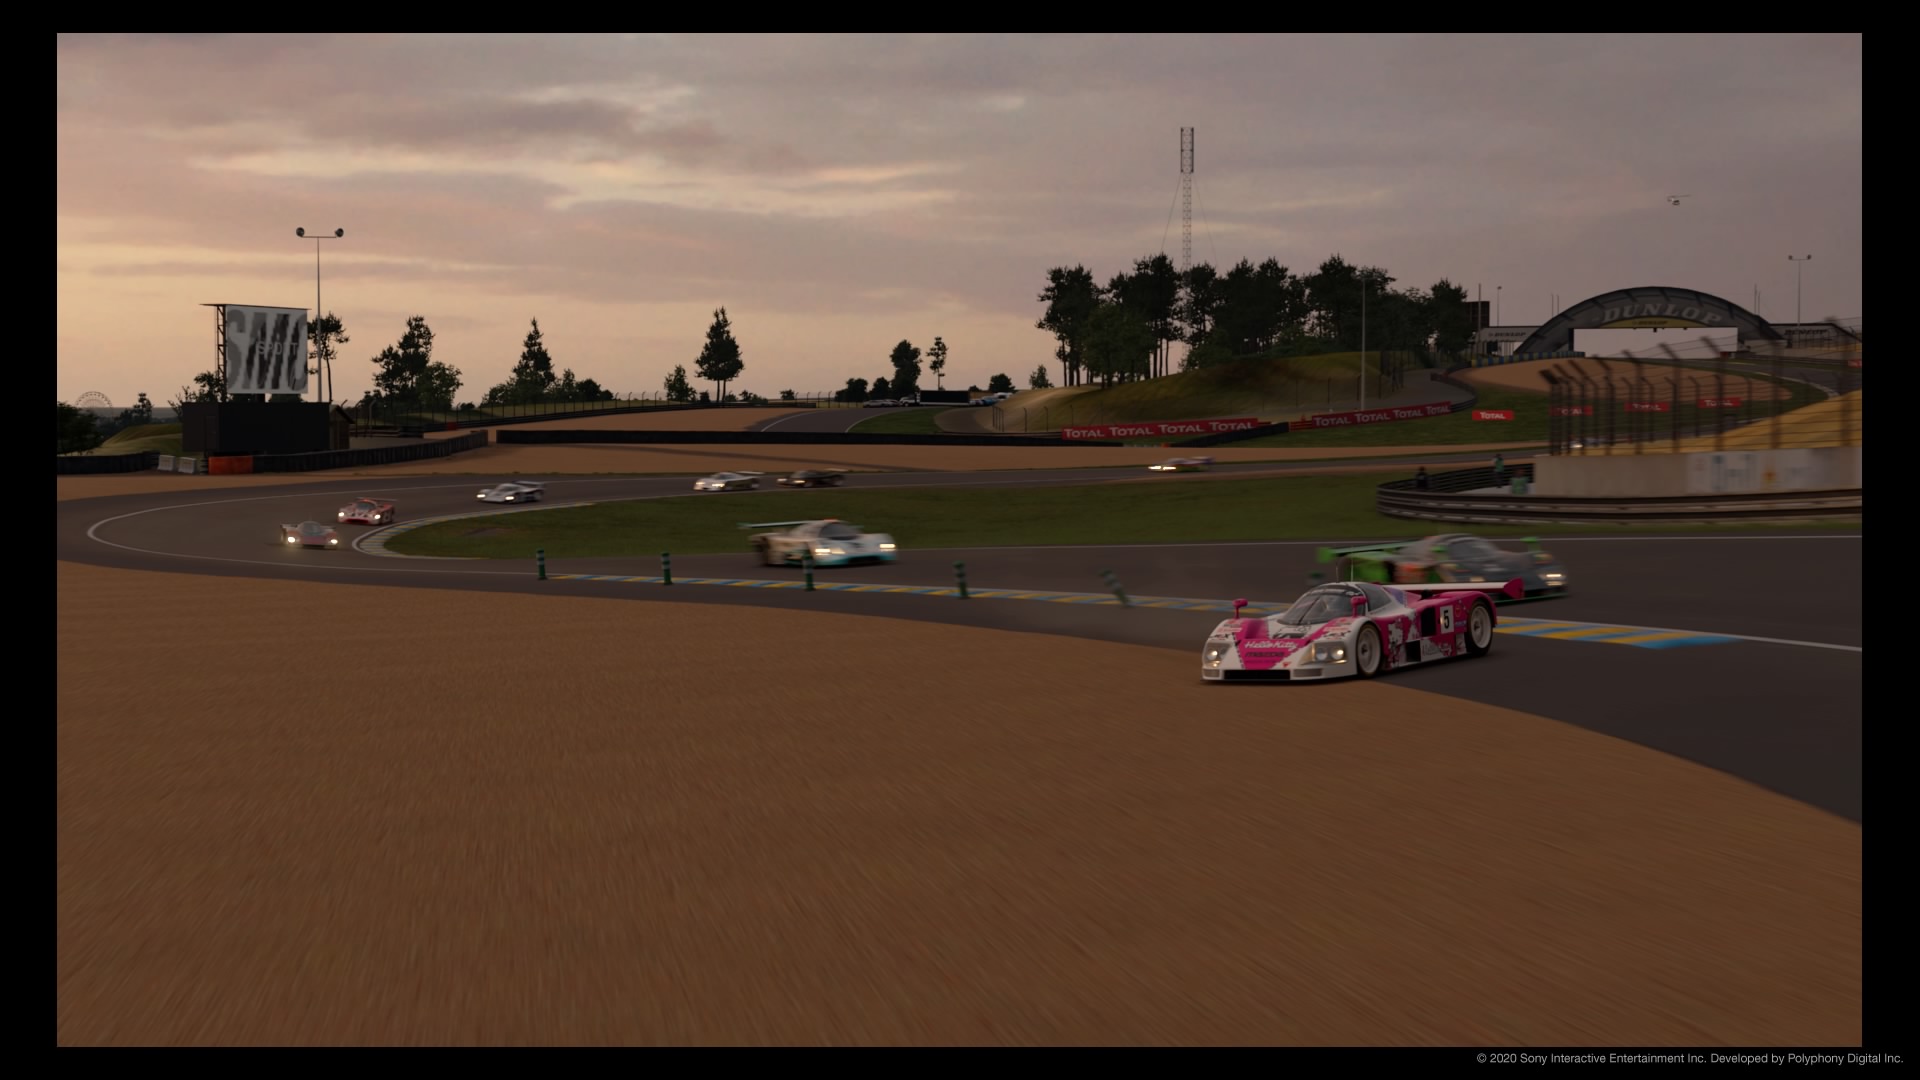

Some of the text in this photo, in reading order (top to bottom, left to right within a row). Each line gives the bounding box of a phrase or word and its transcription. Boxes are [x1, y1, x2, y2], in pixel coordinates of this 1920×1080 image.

[1603, 303, 1722, 324] DUNLOP
[1313, 417, 1352, 426] TOTAL
[1354, 412, 1390, 423] TOTAL
[1393, 409, 1424, 419] TOTAL
[1480, 411, 1506, 420] TOTAL
[1063, 421, 1254, 438] TOTAL TOTAL TOTAL TOTAL
[1443, 610, 1450, 629] 5
[1244, 641, 1272, 649] Hello
